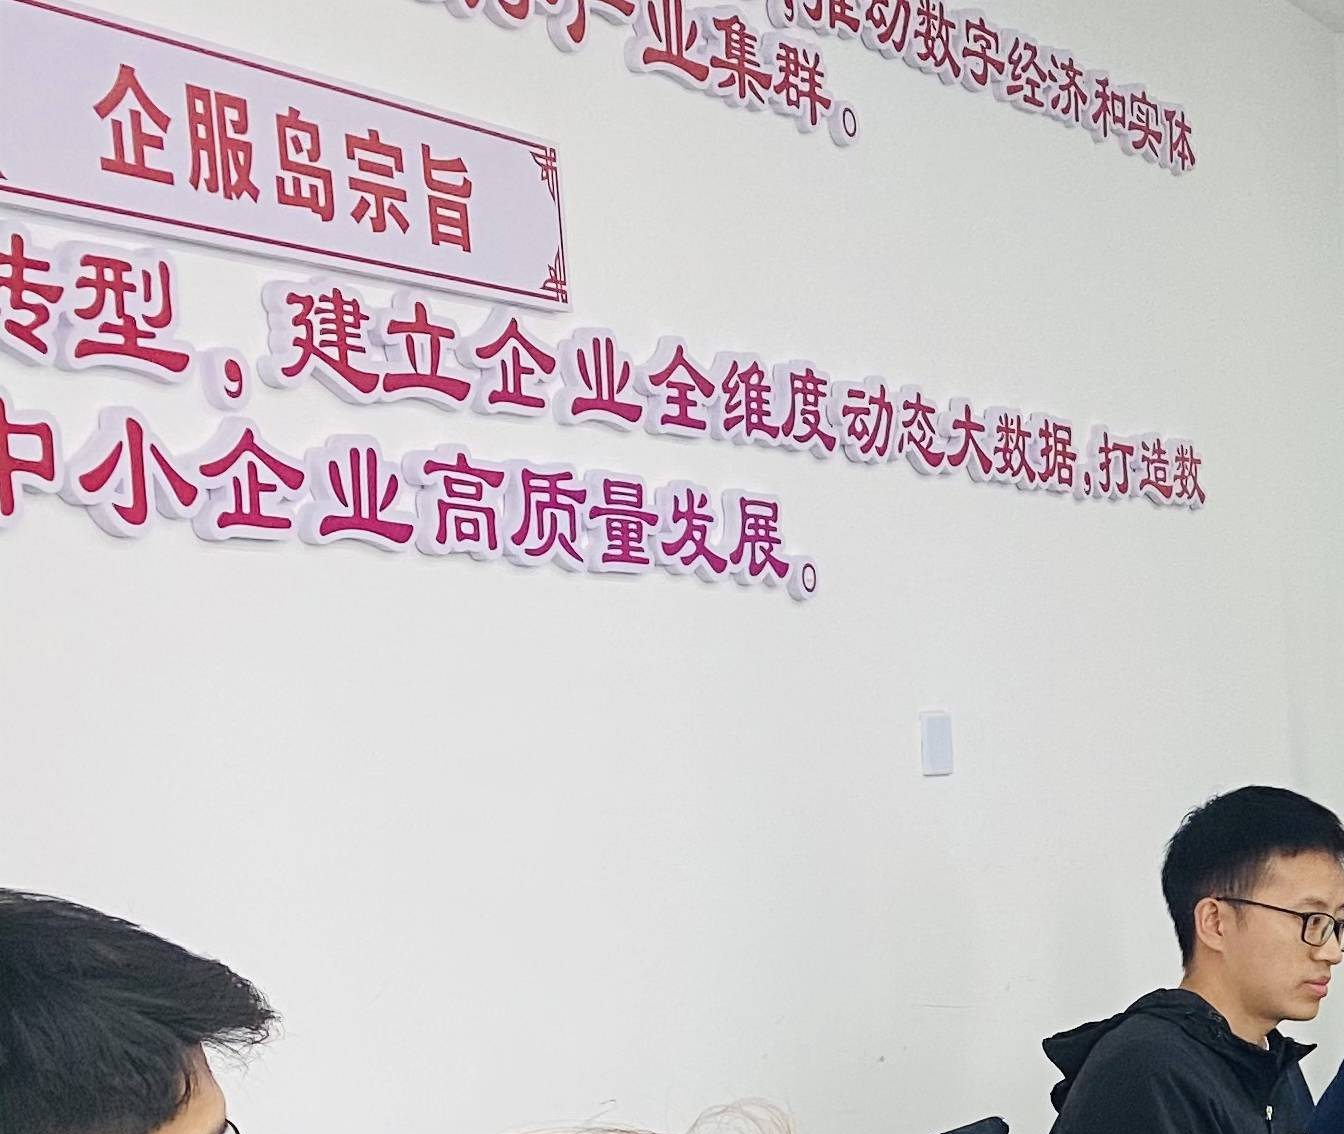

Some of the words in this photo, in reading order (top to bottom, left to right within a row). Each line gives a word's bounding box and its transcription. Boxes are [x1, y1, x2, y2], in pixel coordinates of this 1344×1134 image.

[93, 63, 473, 253] 企服岛宗旨
